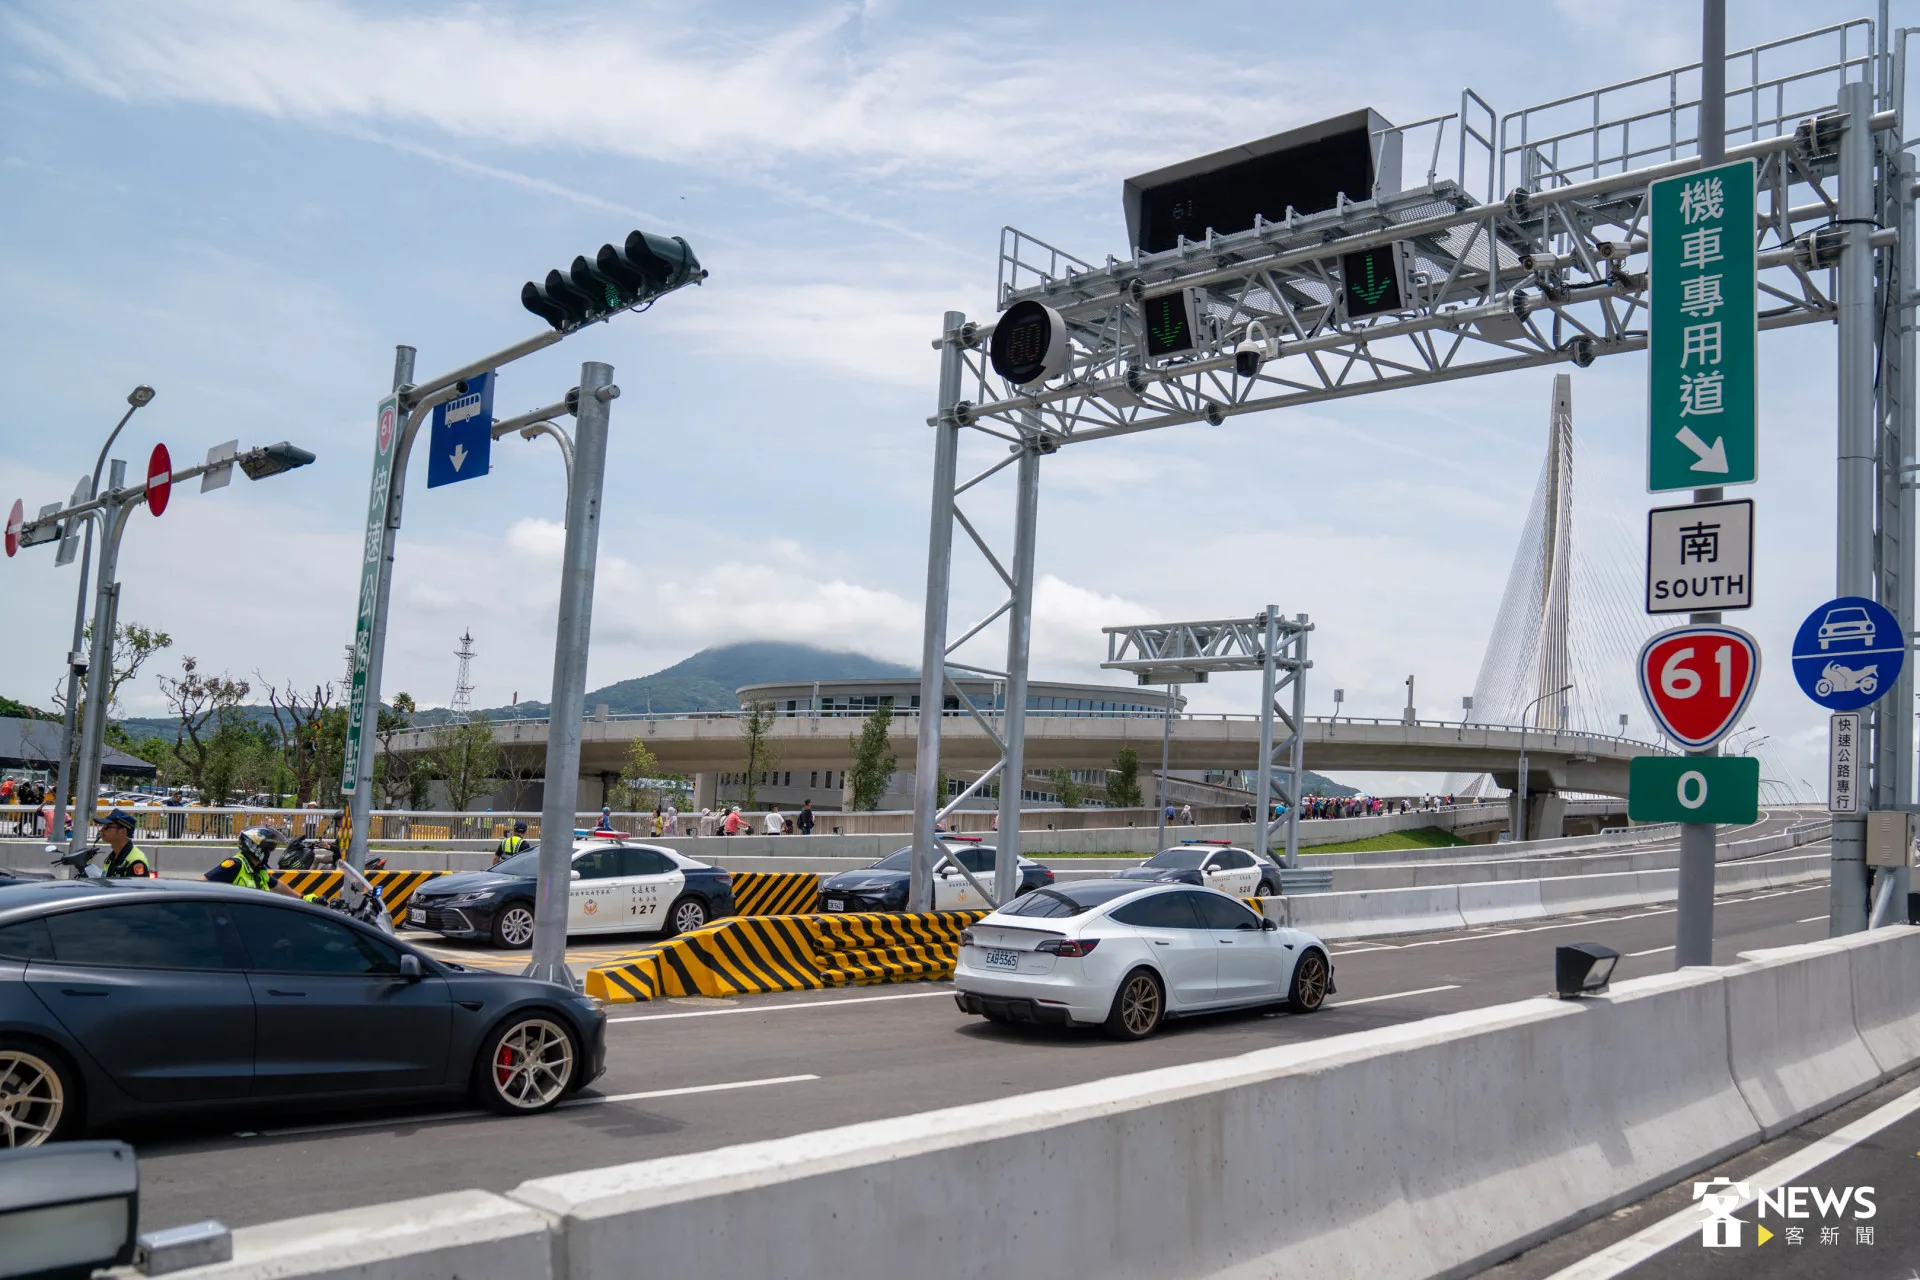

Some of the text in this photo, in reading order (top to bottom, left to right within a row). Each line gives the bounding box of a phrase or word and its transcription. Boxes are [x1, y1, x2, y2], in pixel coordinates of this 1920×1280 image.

[1679, 176, 1725, 418] 機車專用道
[379, 414, 392, 437] 61
[1679, 521, 1721, 565] 南
[1655, 574, 1744, 600] SOUTH
[344, 466, 388, 784] 快速公路起點
[1661, 645, 1732, 700] 61
[1836, 718, 1852, 809] 快速公路專行
[1676, 770, 1708, 810] 0
[631, 904, 656, 915] 127
